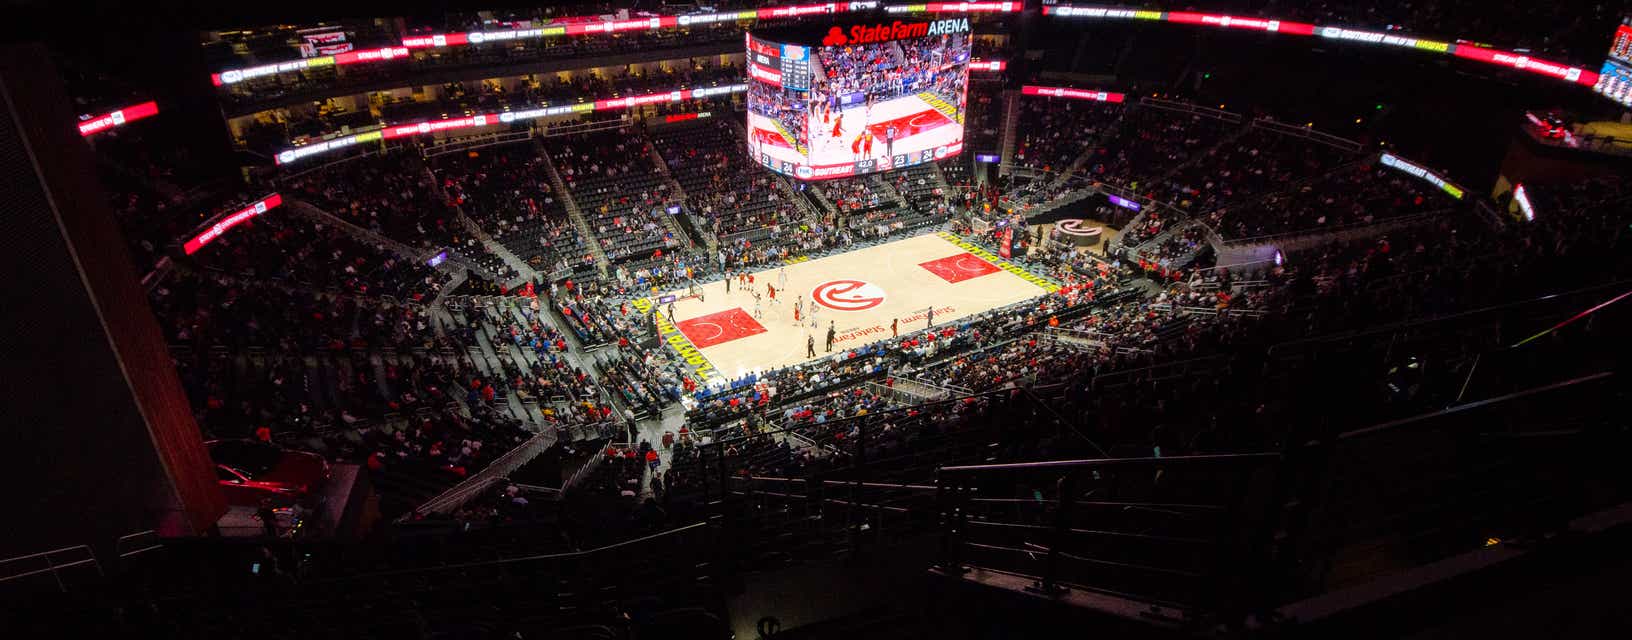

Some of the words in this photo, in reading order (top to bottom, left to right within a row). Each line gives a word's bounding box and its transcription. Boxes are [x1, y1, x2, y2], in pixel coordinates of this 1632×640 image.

[928, 18, 968, 36] ARENA
[895, 155, 904, 165] 23
[923, 150, 932, 160] 24
[783, 163, 792, 173] 24
